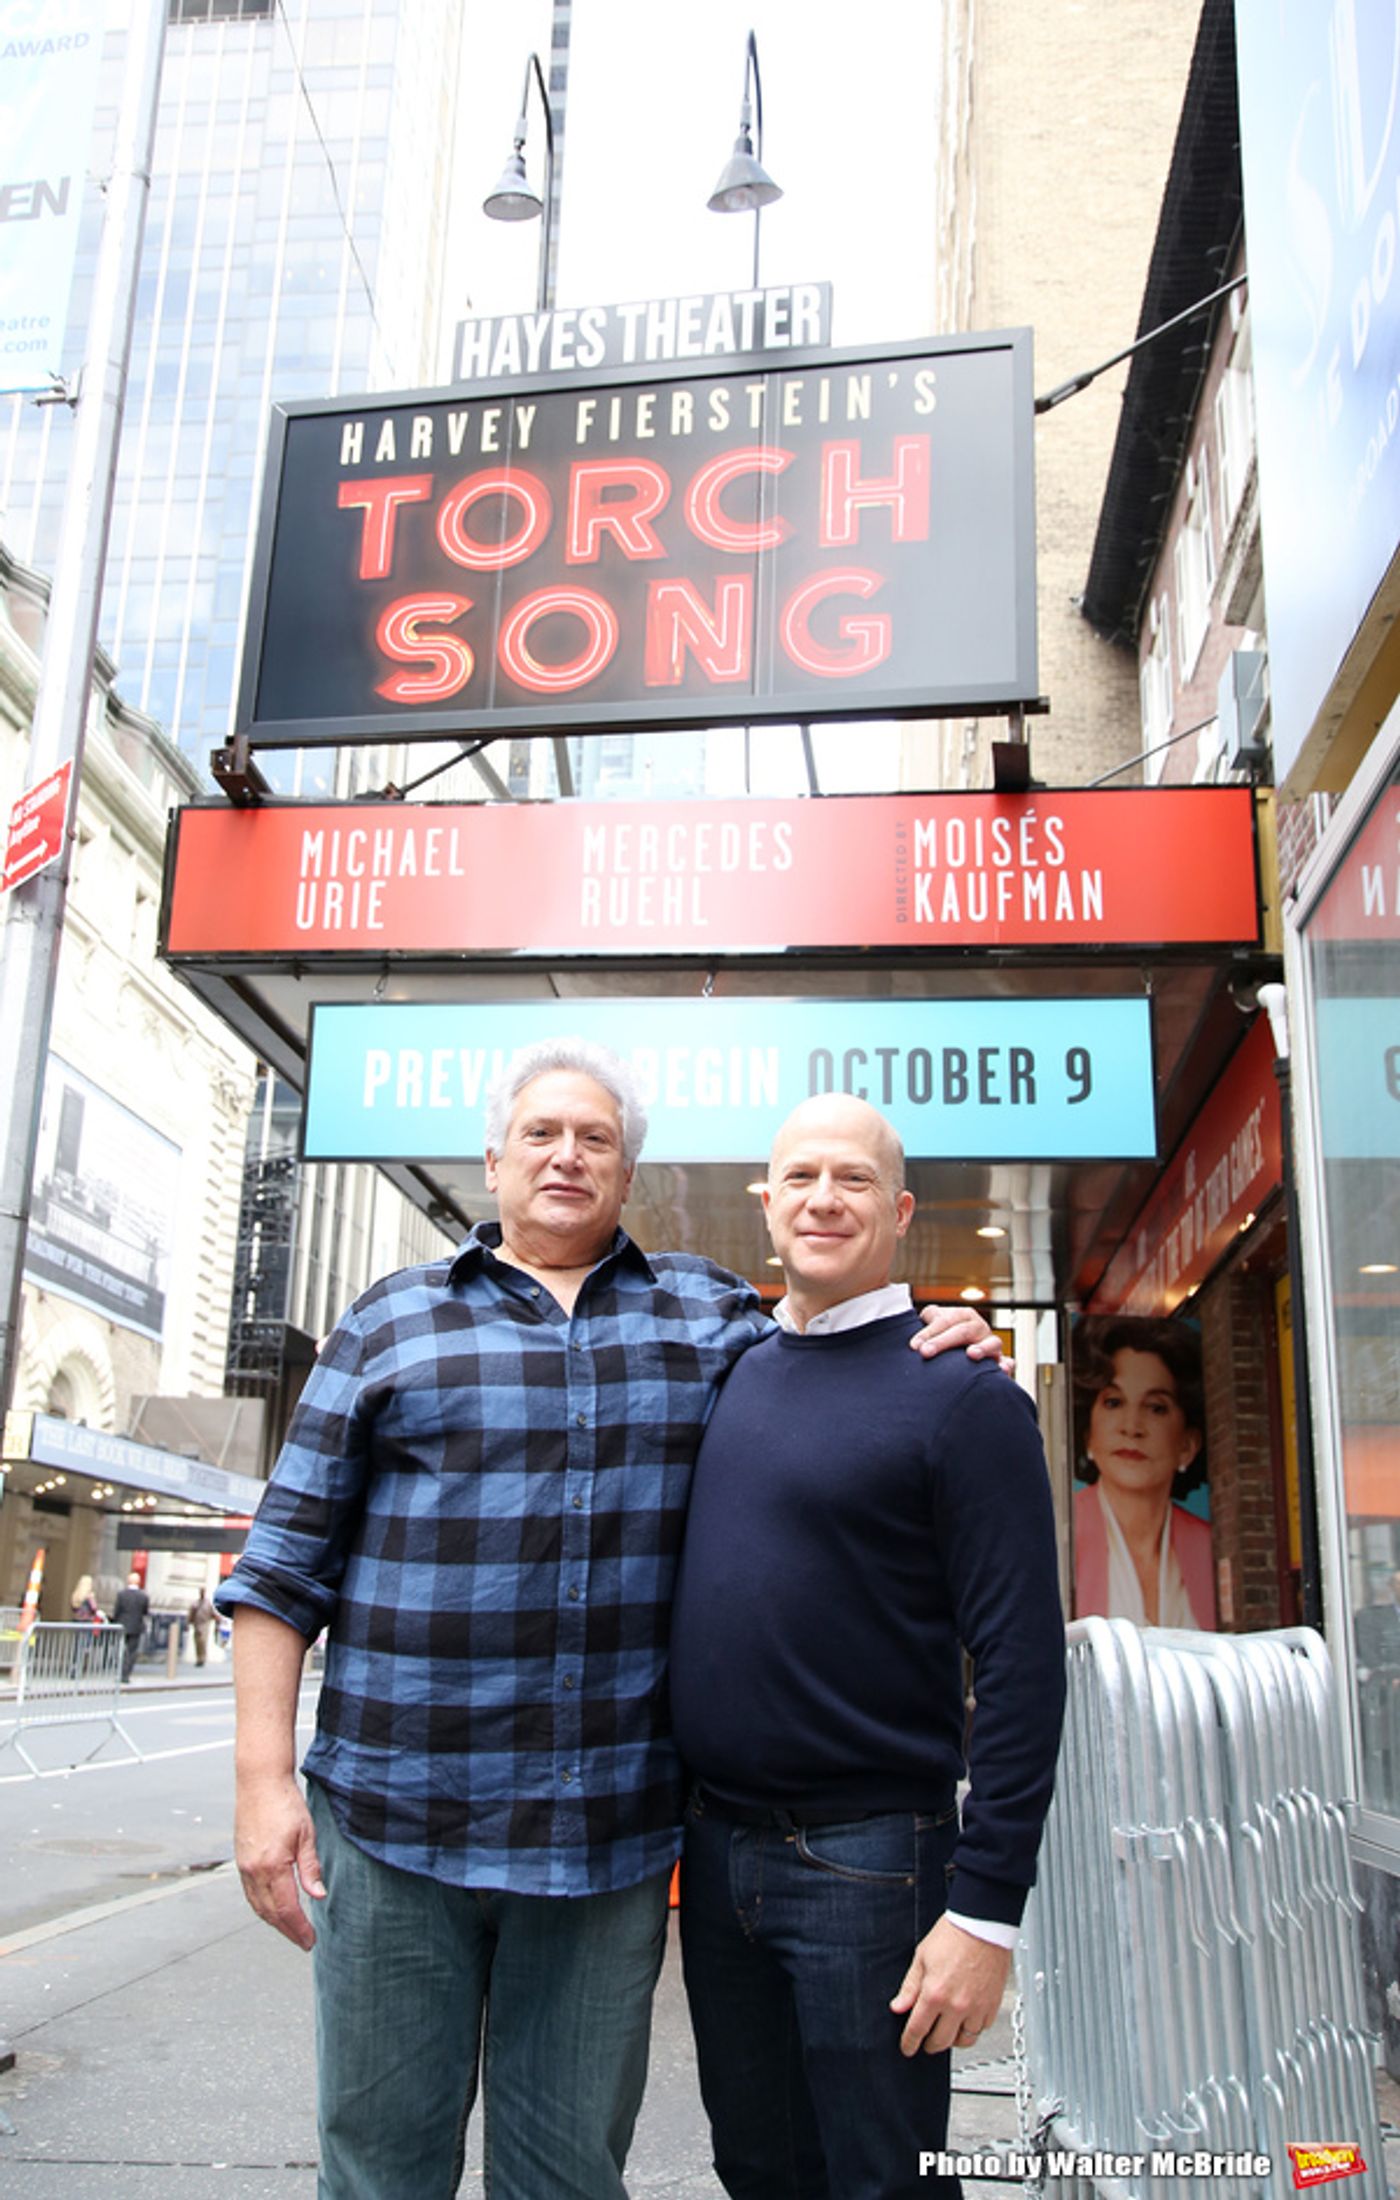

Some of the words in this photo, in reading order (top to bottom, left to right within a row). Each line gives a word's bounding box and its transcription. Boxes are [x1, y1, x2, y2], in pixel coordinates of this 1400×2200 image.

[0, 31, 91, 60] AWARD
[459, 309, 607, 380] HAYES
[614, 284, 822, 364] THEATER
[340, 404, 536, 466] HARVEY
[575, 370, 937, 445] FIERSTEIN'S
[337, 434, 932, 581] TORCH
[373, 565, 893, 705] SONG
[300, 827, 466, 878] MICHAEL
[582, 821, 794, 874] MERCEDES
[913, 809, 1066, 868] MOISÉS
[295, 879, 388, 930] URIE
[580, 876, 709, 928] RUEHL
[895, 844, 908, 924] DIRECTED
[913, 869, 1104, 923] KAUFMAN
[807, 1047, 1037, 1105] OCTOBER
[1065, 1046, 1093, 1105] 9
